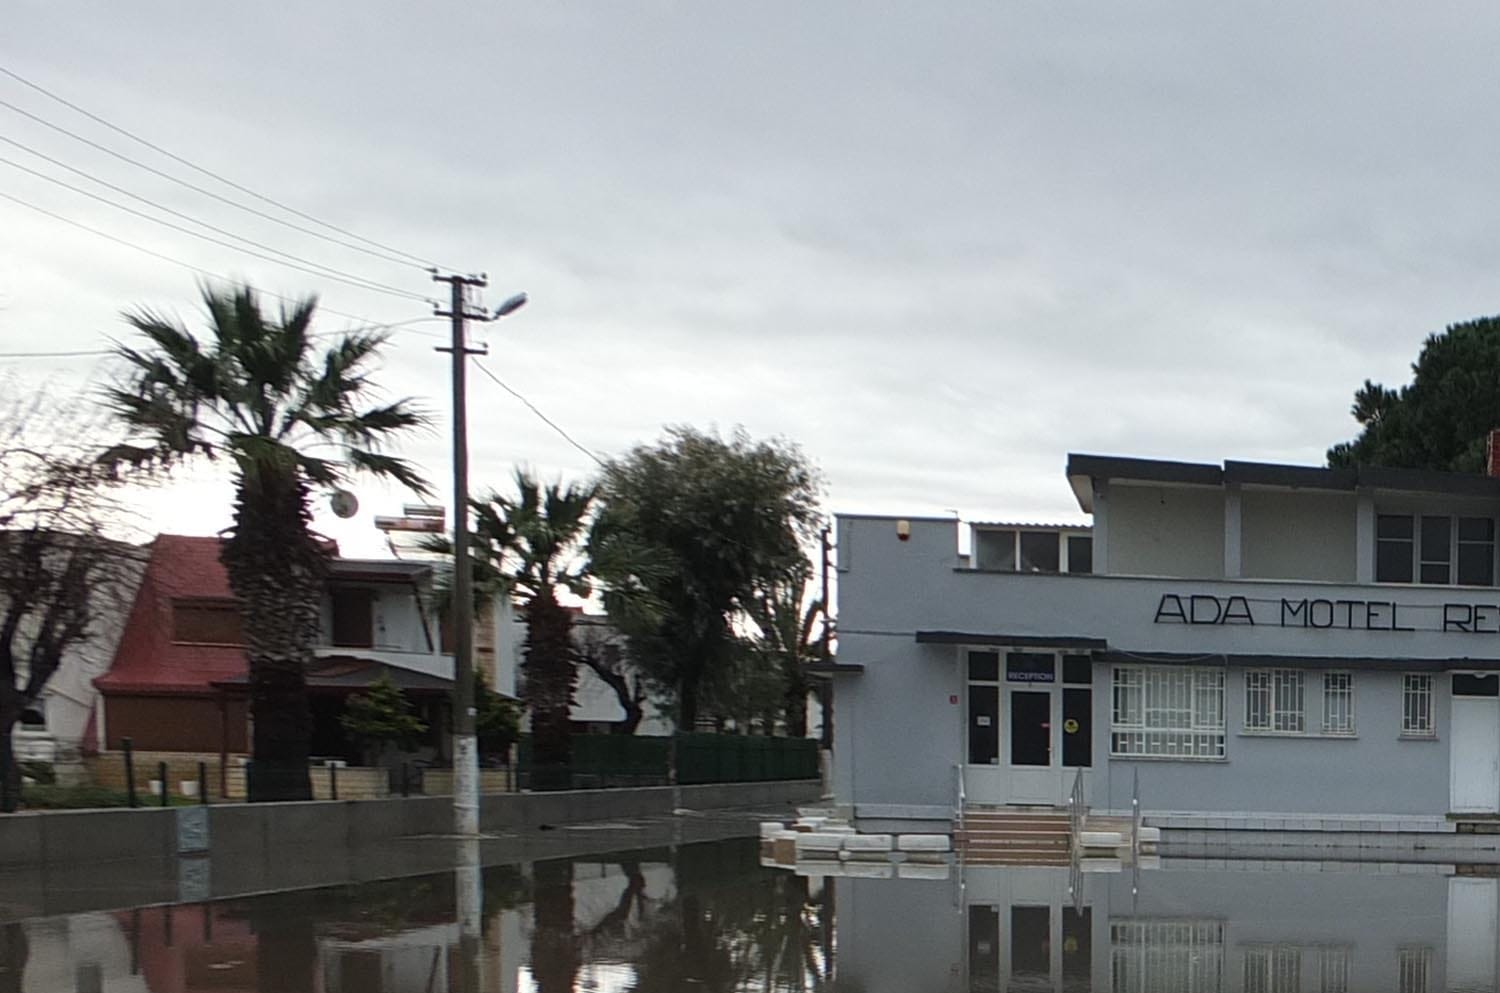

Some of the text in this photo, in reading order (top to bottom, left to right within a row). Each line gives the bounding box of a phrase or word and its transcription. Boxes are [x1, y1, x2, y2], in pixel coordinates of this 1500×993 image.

[1154, 594, 1254, 626] ADA
[1281, 598, 1415, 632] MOTEL
[1008, 671, 1053, 681] RECEPTION
